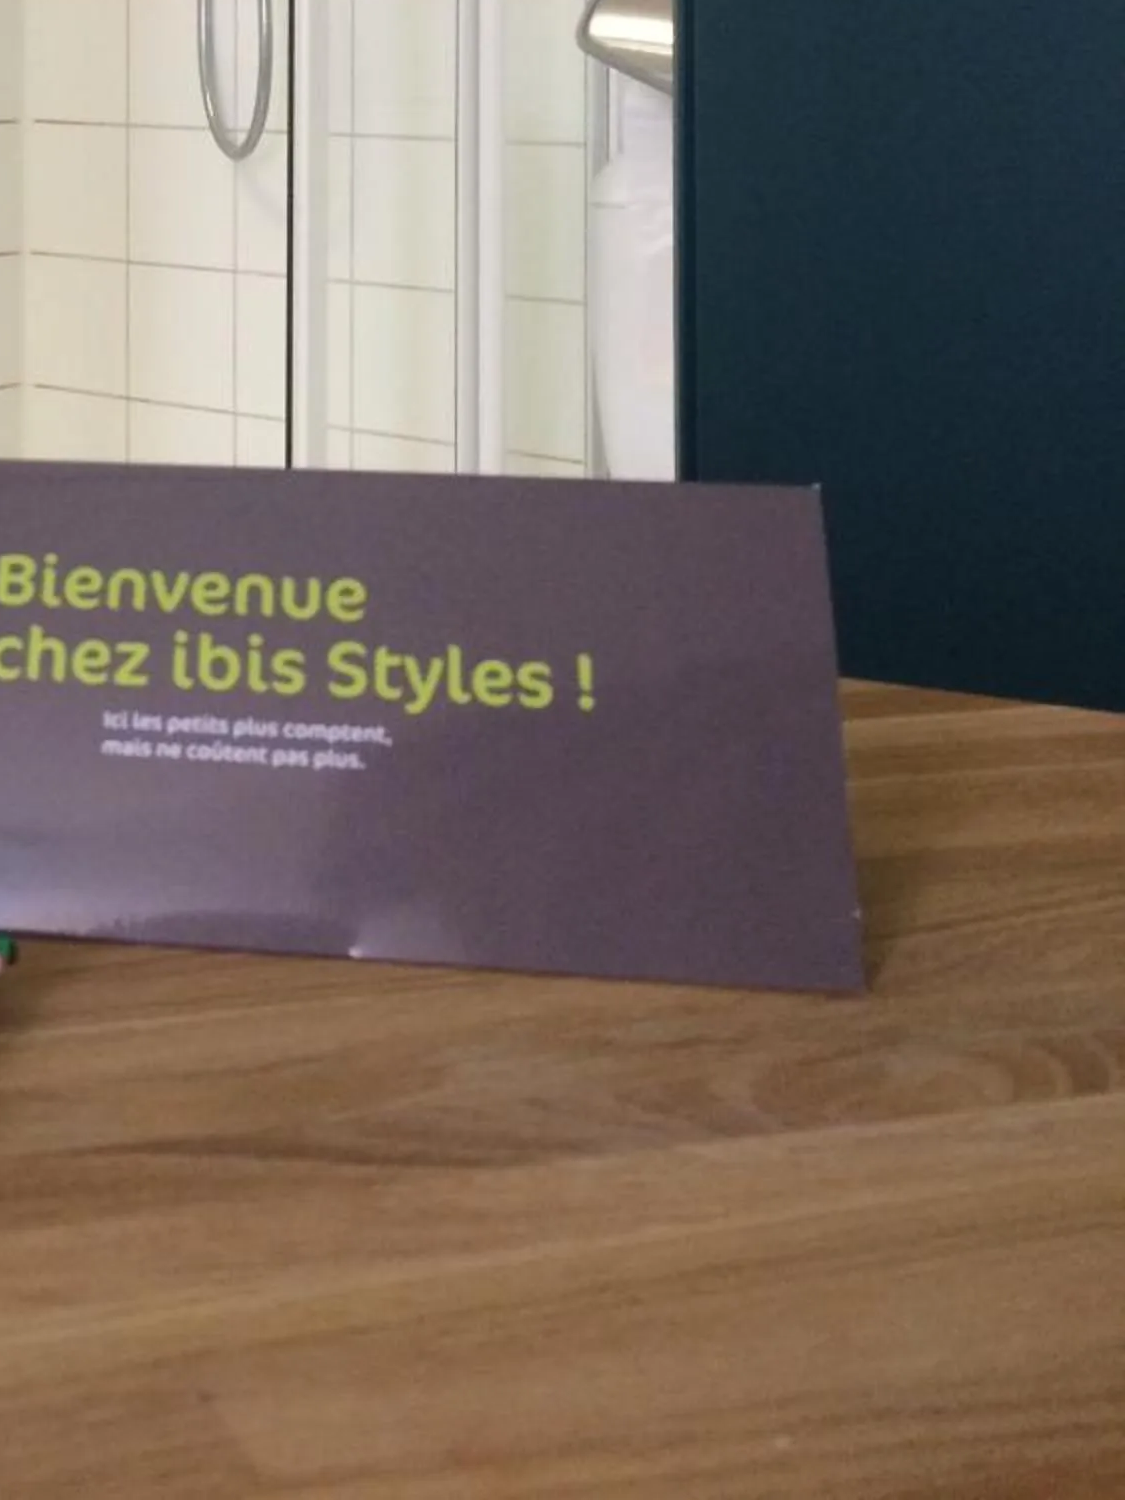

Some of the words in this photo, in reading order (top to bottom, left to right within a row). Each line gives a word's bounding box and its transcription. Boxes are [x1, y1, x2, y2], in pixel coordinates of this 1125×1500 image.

[172, 630, 307, 695] ibis
[326, 641, 554, 715] Styles
[103, 711, 127, 730] Ici
[132, 712, 162, 732] les
[166, 714, 229, 736] petits
[232, 716, 278, 739] plus
[282, 721, 393, 747] comptent,
[101, 738, 153, 758] mais
[156, 742, 182, 759] ne
[272, 748, 309, 768] pas
[312, 747, 367, 770] plus.
